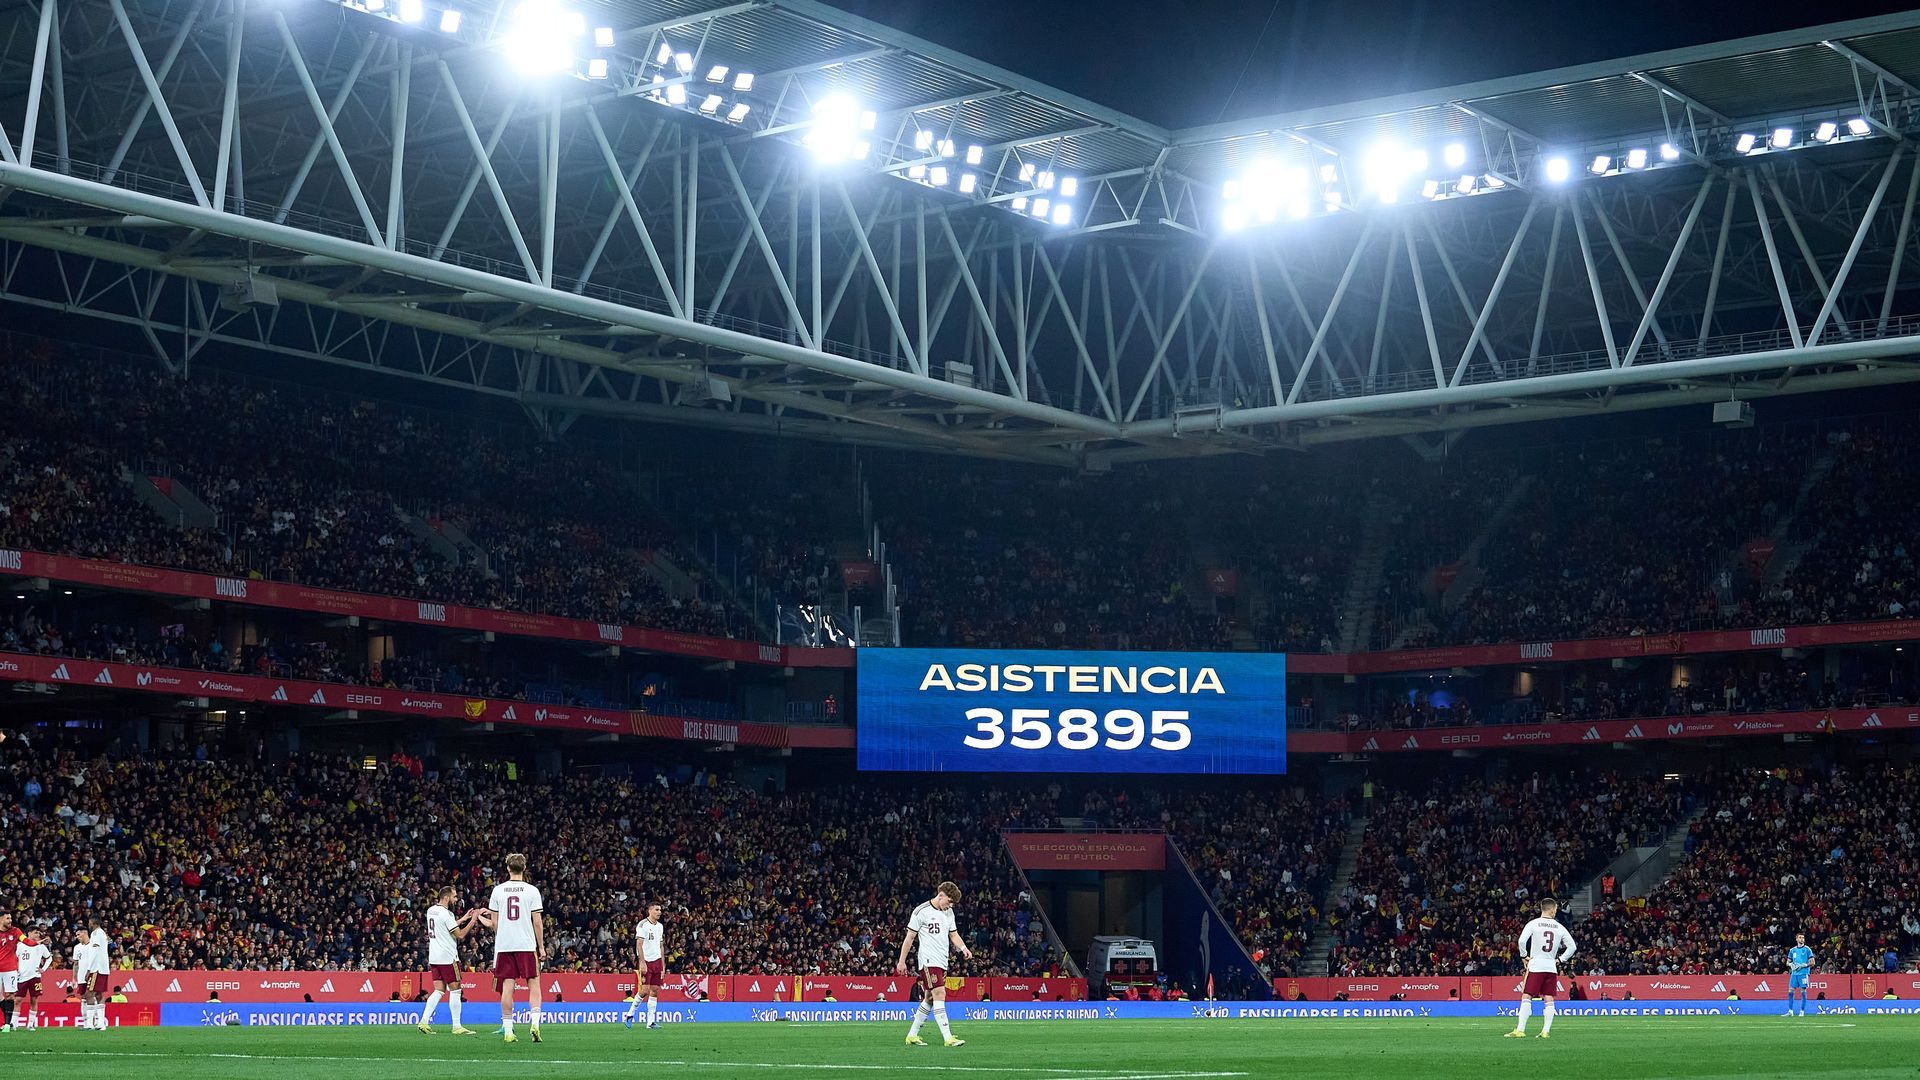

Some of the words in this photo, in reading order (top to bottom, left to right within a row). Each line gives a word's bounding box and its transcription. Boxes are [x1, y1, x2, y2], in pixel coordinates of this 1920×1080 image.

[215, 577, 247, 597] VAMOS
[417, 602, 445, 622] VAMOS
[597, 623, 623, 641] VAMOS
[1750, 628, 1786, 645] VAMOS
[758, 645, 781, 662] VAMOS
[1520, 642, 1553, 659] VAMOS
[154, 676, 181, 685] movistar
[919, 664, 1226, 694] ASISTENCIA
[210, 681, 232, 692] Halcón
[413, 700, 443, 711] mapfre
[549, 713, 570, 721] movistar
[963, 707, 1193, 751] 35895
[1686, 723, 1714, 731] movistar
[1746, 721, 1771, 729] Halcón
[683, 721, 703, 739] RCDE
[704, 723, 738, 743] STADIUM
[1516, 730, 1551, 741] mapfre
[1022, 843, 1085, 851] SELECCIÓN
[1088, 843, 1146, 852] ESPAÑOLA
[1073, 853, 1116, 861] FÚTBOL
[508, 896, 520, 921] 6
[928, 922, 940, 934] 25
[1542, 930, 1555, 953] 3
[22, 952, 30, 961] 20
[206, 981, 240, 990] EBRO
[272, 980, 300, 990] mapfre
[1411, 983, 1439, 992] mapfre
[540, 1011, 618, 1023] ENSUCIARSE
[785, 1010, 852, 1022] ENSUCIARSE
[855, 1010, 867, 1021] ES
[870, 1010, 907, 1021] BUENO
[994, 1009, 1052, 1020] ENSUCIARSE
[1054, 1009, 1064, 1020] ES
[1067, 1009, 1099, 1019] BUENO
[1239, 1008, 1338, 1018] ENSUCIARSE
[1343, 1008, 1359, 1017] ES
[1364, 1008, 1414, 1017] BUENO
[250, 1012, 344, 1026] ENSUCIARSE
[348, 1012, 364, 1025] ES
[368, 1012, 420, 1025] BUENO
